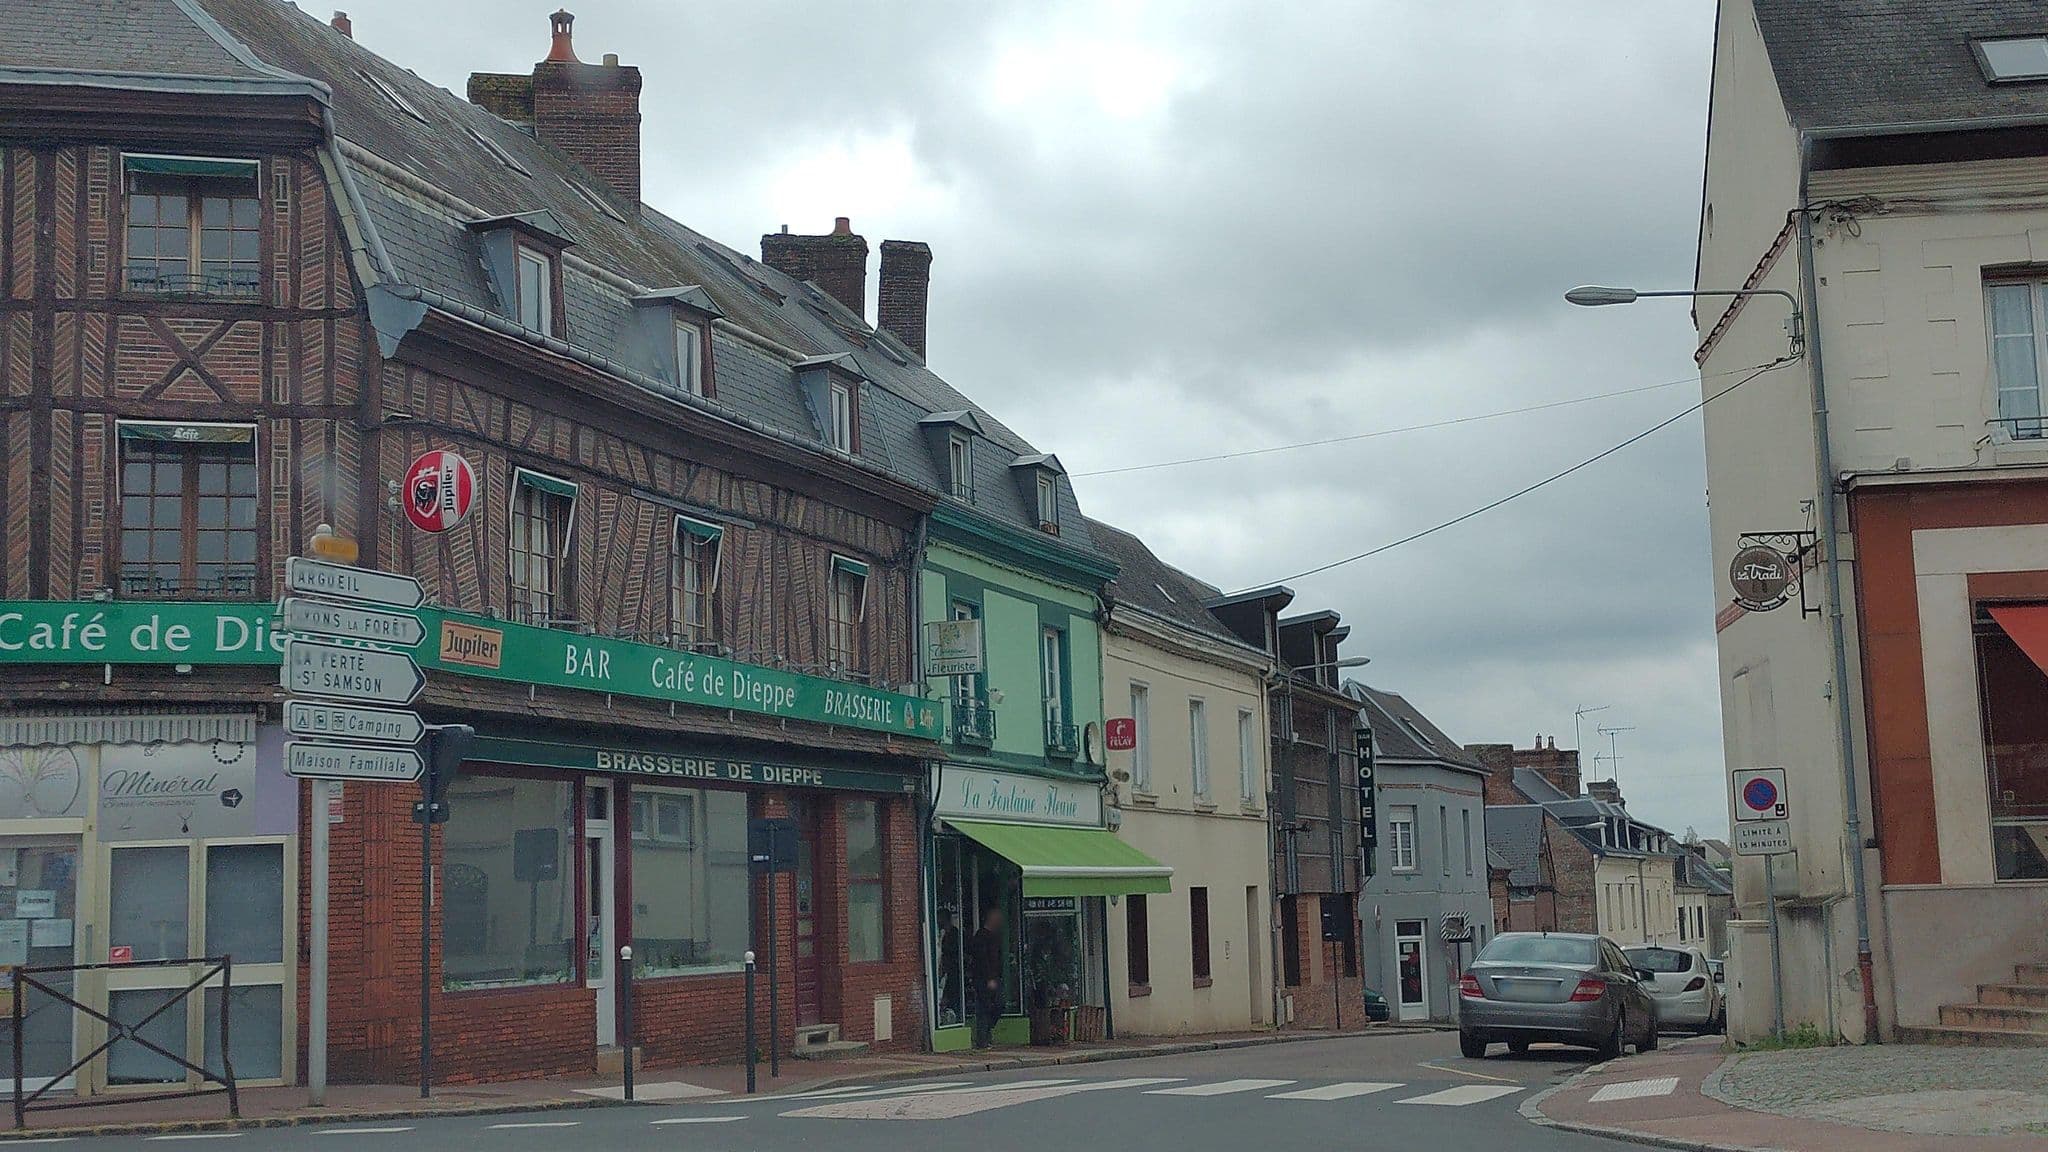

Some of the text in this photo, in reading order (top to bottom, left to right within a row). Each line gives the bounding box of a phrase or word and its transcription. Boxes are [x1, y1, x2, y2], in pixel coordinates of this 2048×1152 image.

[442, 465, 456, 514] Jupiler
[298, 571, 360, 593] ARGUEIL
[1743, 563, 1783, 581] Tradi
[0, 612, 107, 652] Café
[131, 613, 191, 652] de
[446, 629, 498, 662] Jupiler
[565, 644, 611, 680] BAR
[932, 662, 977, 674] Fleuriste
[323, 673, 382, 693] SAMSON
[651, 656, 796, 712] Café de Dieppe
[824, 689, 893, 724] BRASSERIE
[349, 714, 402, 738] Camping
[295, 751, 406, 773] Maison Familiale
[596, 751, 823, 786] BRASSERIE DE DIEPPE
[103, 769, 219, 796] Minéral
[962, 775, 981, 809] La
[987, 778, 1036, 814] Fontaine
[1359, 746, 1374, 839] HOTEL
[1739, 839, 1788, 849] 15 MINUTES
